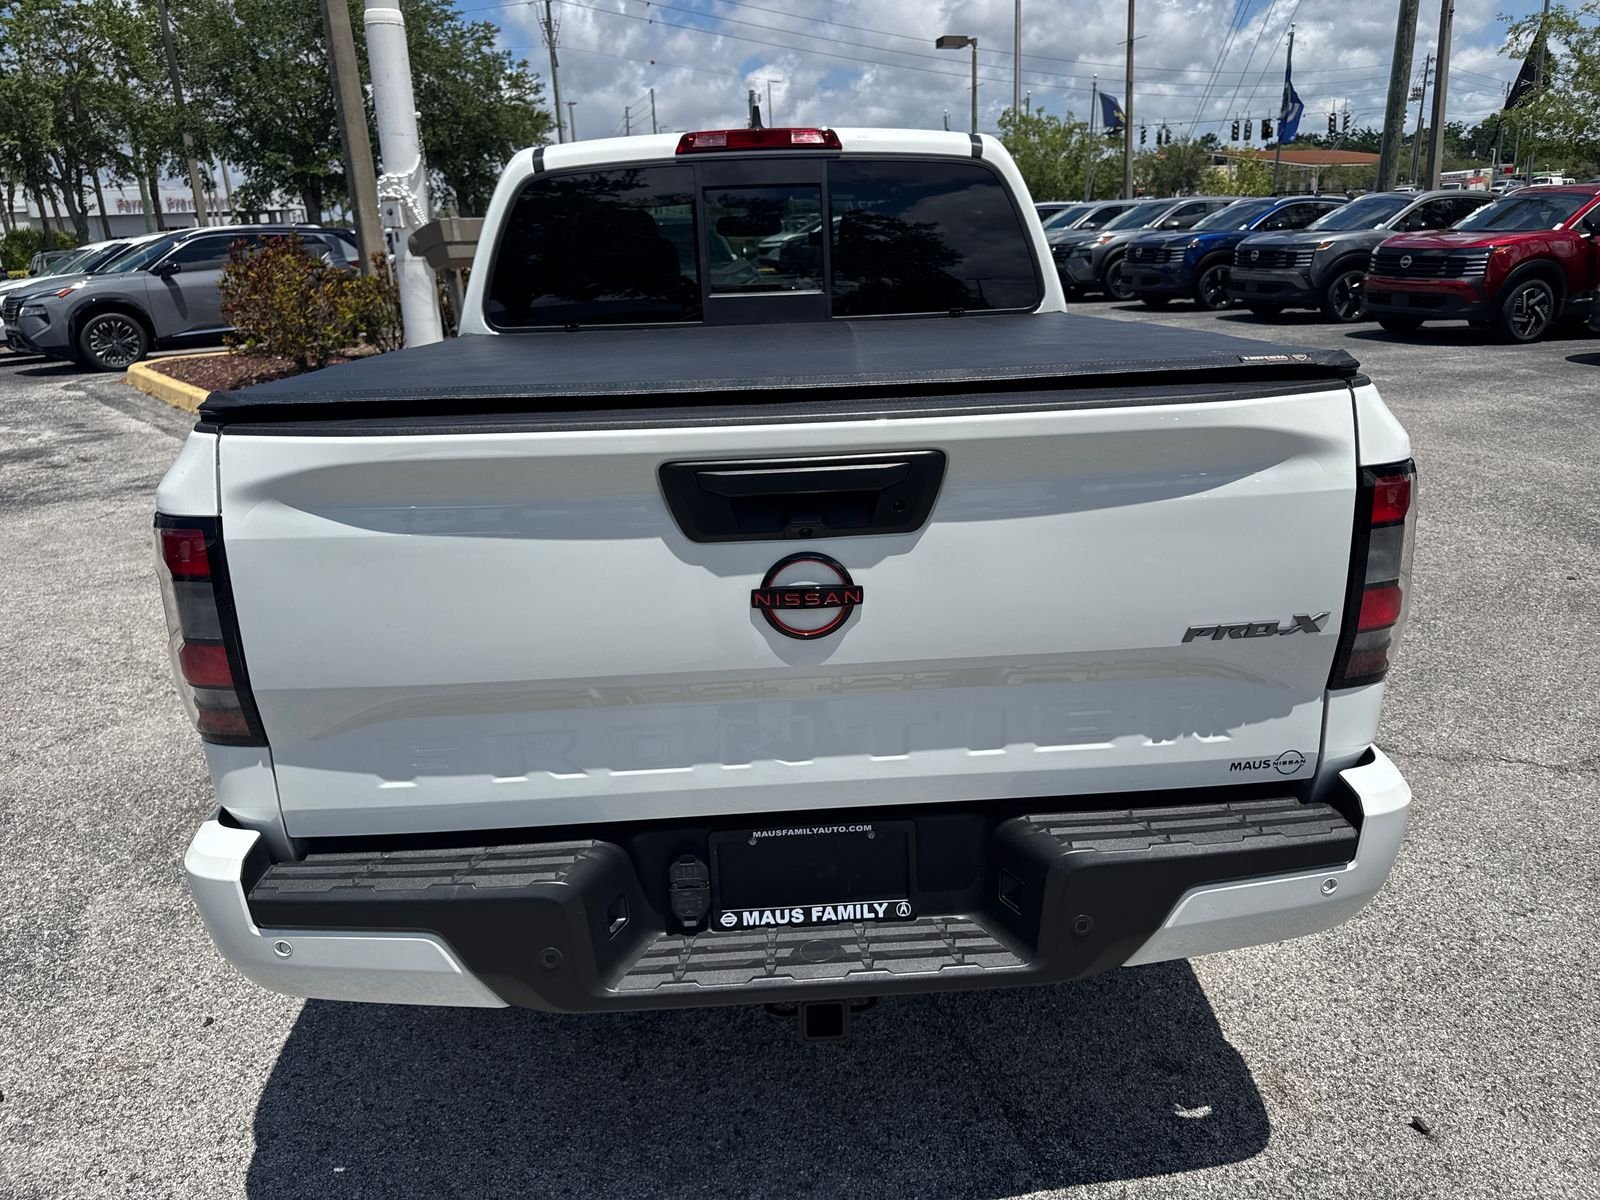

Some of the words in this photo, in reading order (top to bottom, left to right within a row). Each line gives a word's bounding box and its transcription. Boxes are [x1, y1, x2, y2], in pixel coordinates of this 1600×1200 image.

[754, 590, 860, 607] NISSAN
[1181, 611, 1331, 643] PRO-X
[1229, 759, 1271, 772] MAUS
[1272, 758, 1306, 767] NISSAN
[752, 824, 872, 838] MAUSFAMILYAUTO.COM
[742, 908, 804, 926] MAUS
[811, 902, 889, 922] FAMILY
